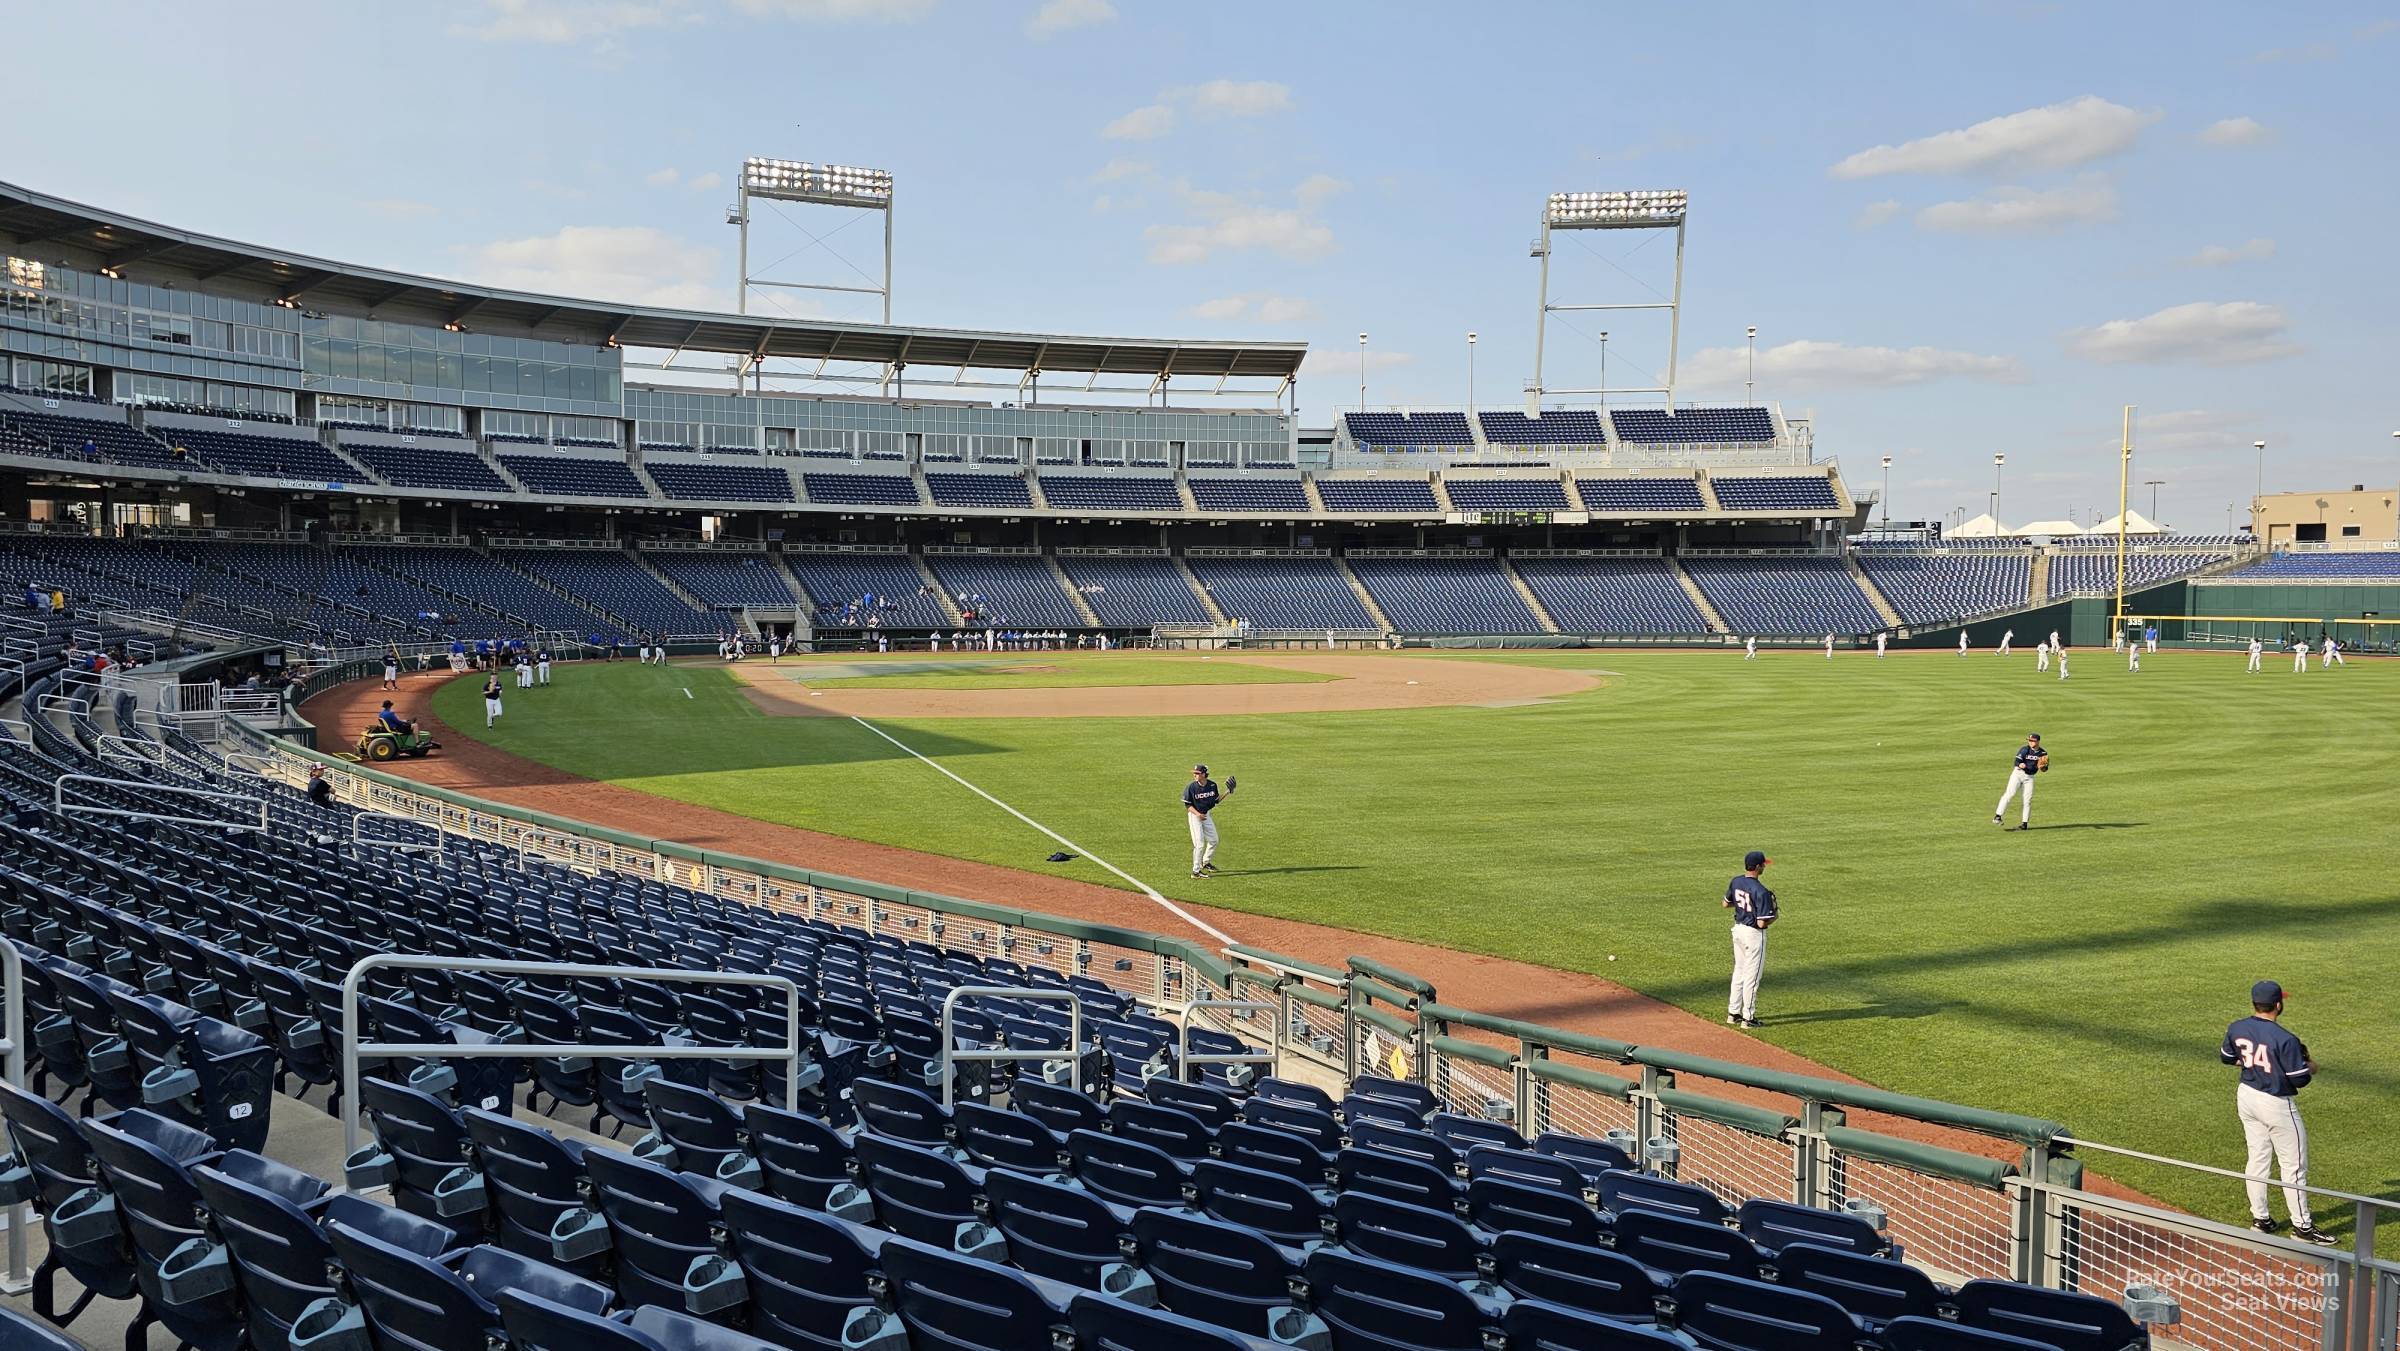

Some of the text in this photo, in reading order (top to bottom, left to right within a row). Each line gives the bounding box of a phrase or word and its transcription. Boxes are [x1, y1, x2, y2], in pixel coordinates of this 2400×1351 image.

[2127, 618, 2143, 626] 335
[745, 644, 763, 652] 0:20
[1195, 791, 1216, 799] UCONN
[1734, 888, 1752, 912] 51
[2234, 1038, 2271, 1074] 34
[235, 1105, 247, 1116] 12
